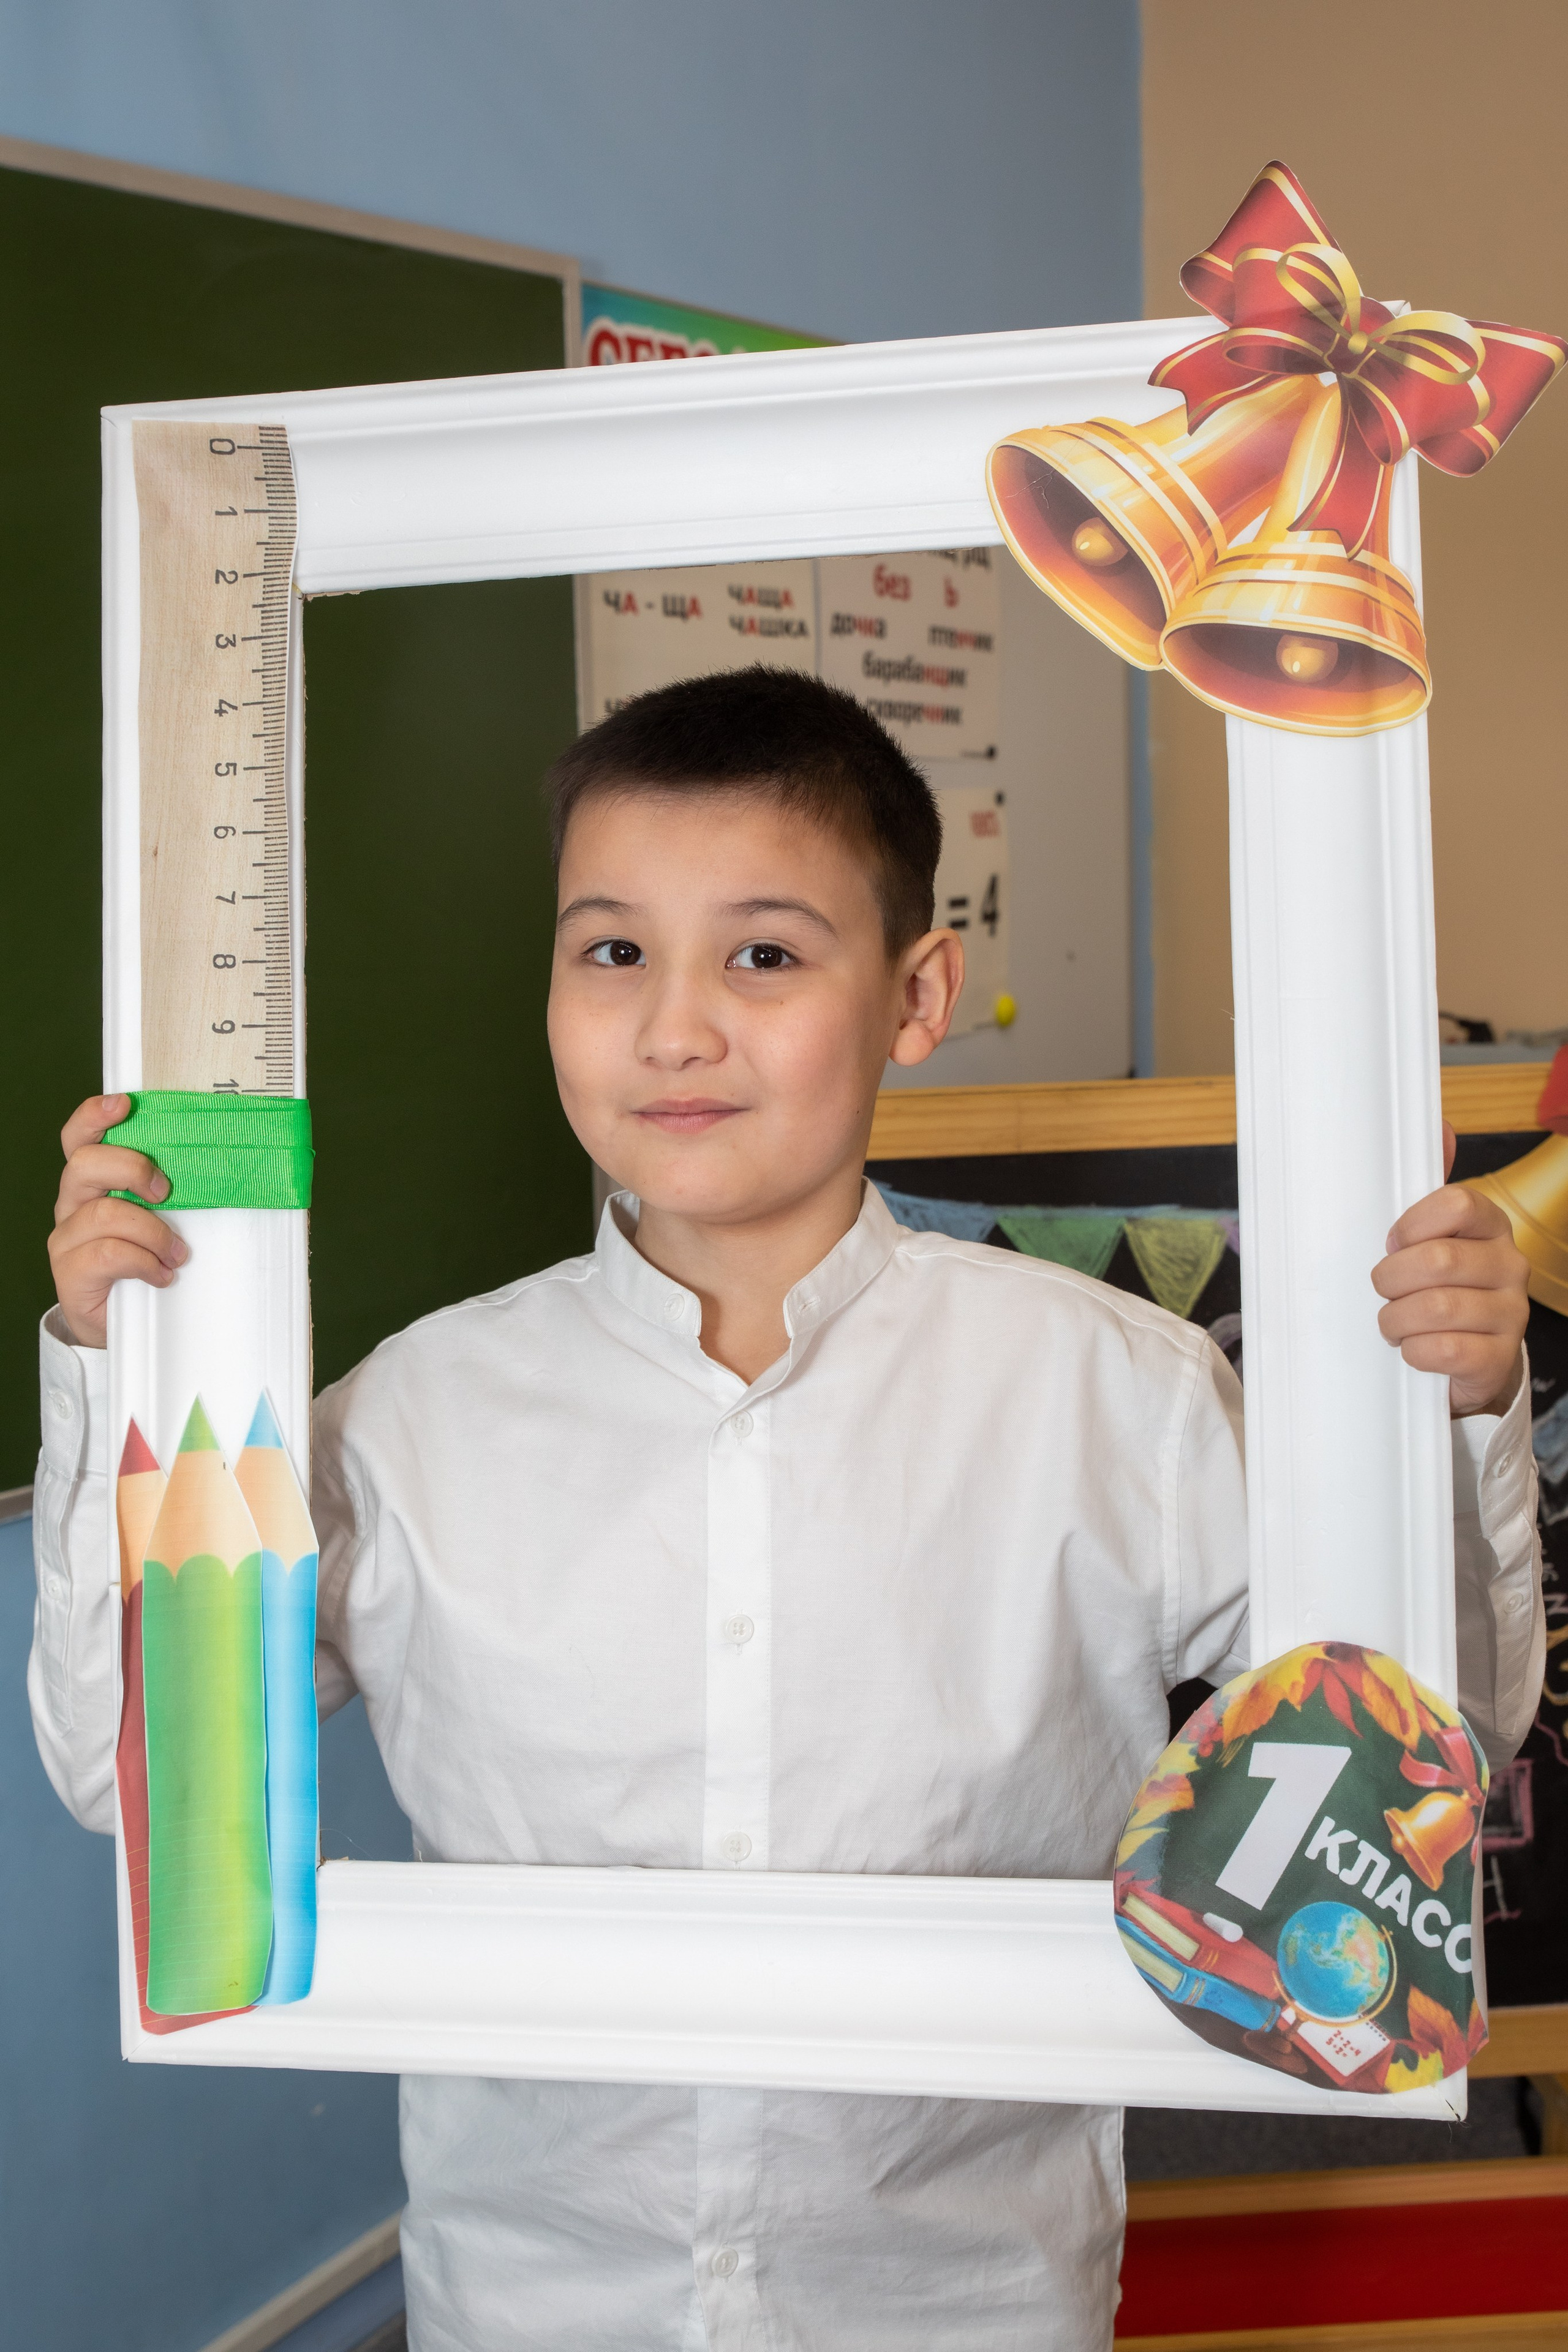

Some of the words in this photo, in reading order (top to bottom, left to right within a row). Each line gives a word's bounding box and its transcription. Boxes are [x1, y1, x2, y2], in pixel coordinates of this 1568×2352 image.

[209, 439, 235, 455] 0
[215, 507, 238, 516] 1
[215, 570, 238, 584] 2
[873, 563, 911, 601] без
[604, 590, 638, 615] ЧА
[663, 594, 702, 622] ЩА
[729, 616, 809, 638] ЧАШКА
[216, 635, 236, 649] 3
[214, 699, 238, 717] 4
[215, 763, 237, 777] 5
[214, 826, 236, 839] 6
[215, 891, 236, 905] 7
[982, 875, 998, 937] 4
[213, 954, 236, 969] 8
[212, 1020, 235, 1035] 9
[213, 1079, 239, 1095] 1
[1215, 1742, 1352, 1910] 1
[1304, 1816, 1472, 1973] КЛАСС
